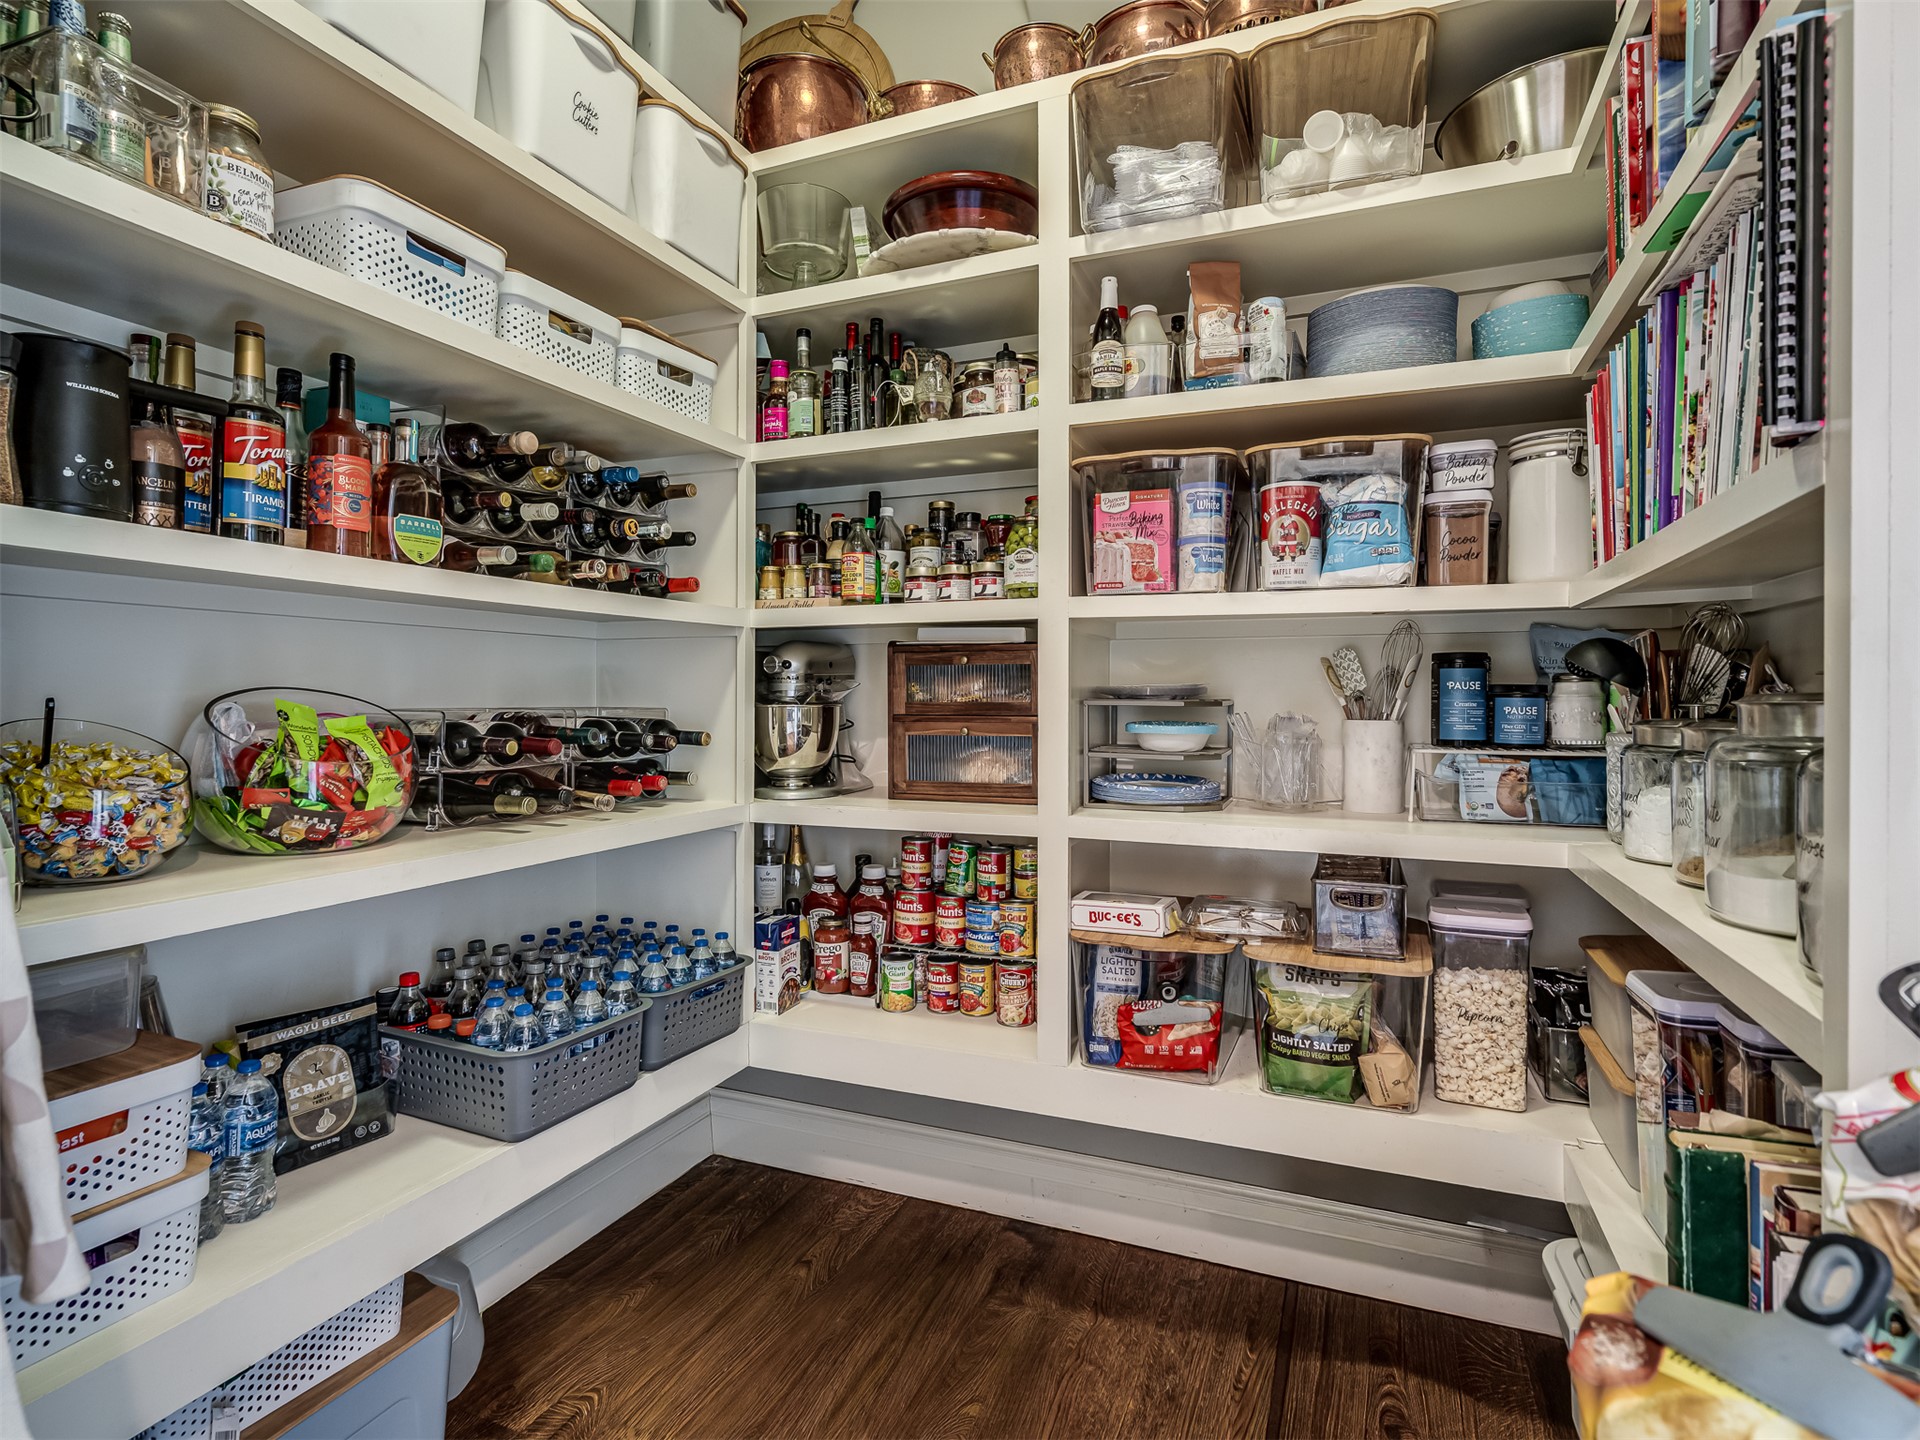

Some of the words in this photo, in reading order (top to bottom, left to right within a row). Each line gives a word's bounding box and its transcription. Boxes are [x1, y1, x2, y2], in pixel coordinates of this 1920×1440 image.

[573, 91, 599, 120] Cookie
[227, 162, 274, 191] BELMONT
[1446, 453, 1489, 472] Baking
[1445, 468, 1488, 486] Powder
[1196, 500, 1220, 510] White
[400, 519, 440, 531] BARRELL
[1128, 510, 1164, 527] Baking
[1134, 525, 1158, 540] Mix
[1326, 512, 1397, 545] Sugar
[1442, 531, 1479, 548] Cocoa
[1440, 547, 1481, 564] Powder
[1448, 681, 1481, 690] PAUSE
[1504, 706, 1538, 715] PAUSE
[896, 900, 923, 912] Hunt's
[936, 906, 963, 917] Hunt's
[1007, 913, 1028, 923] GOLD
[967, 931, 994, 941] StarKist
[781, 951, 797, 963] BROTH
[815, 944, 841, 957] Prego
[1101, 956, 1137, 967] LIGHTLY
[966, 974, 986, 983] GOLD
[1102, 966, 1136, 976] SALTED
[1285, 967, 1341, 987] SNAPS
[1000, 978, 1025, 987] CHUNKY
[1457, 1006, 1505, 1027] Popcorn
[276, 1022, 319, 1041] WAGYU
[322, 1012, 353, 1028] BEEF
[1272, 1032, 1311, 1049] LIGHTLY
[1313, 1041, 1351, 1053] SALTED
[1271, 1043, 1292, 1056] Crispy
[1292, 1048, 1310, 1058] BAKED
[1311, 1051, 1331, 1060] VEGGIE
[1332, 1053, 1350, 1061] SNACKS
[288, 1070, 350, 1100] KRAVE
